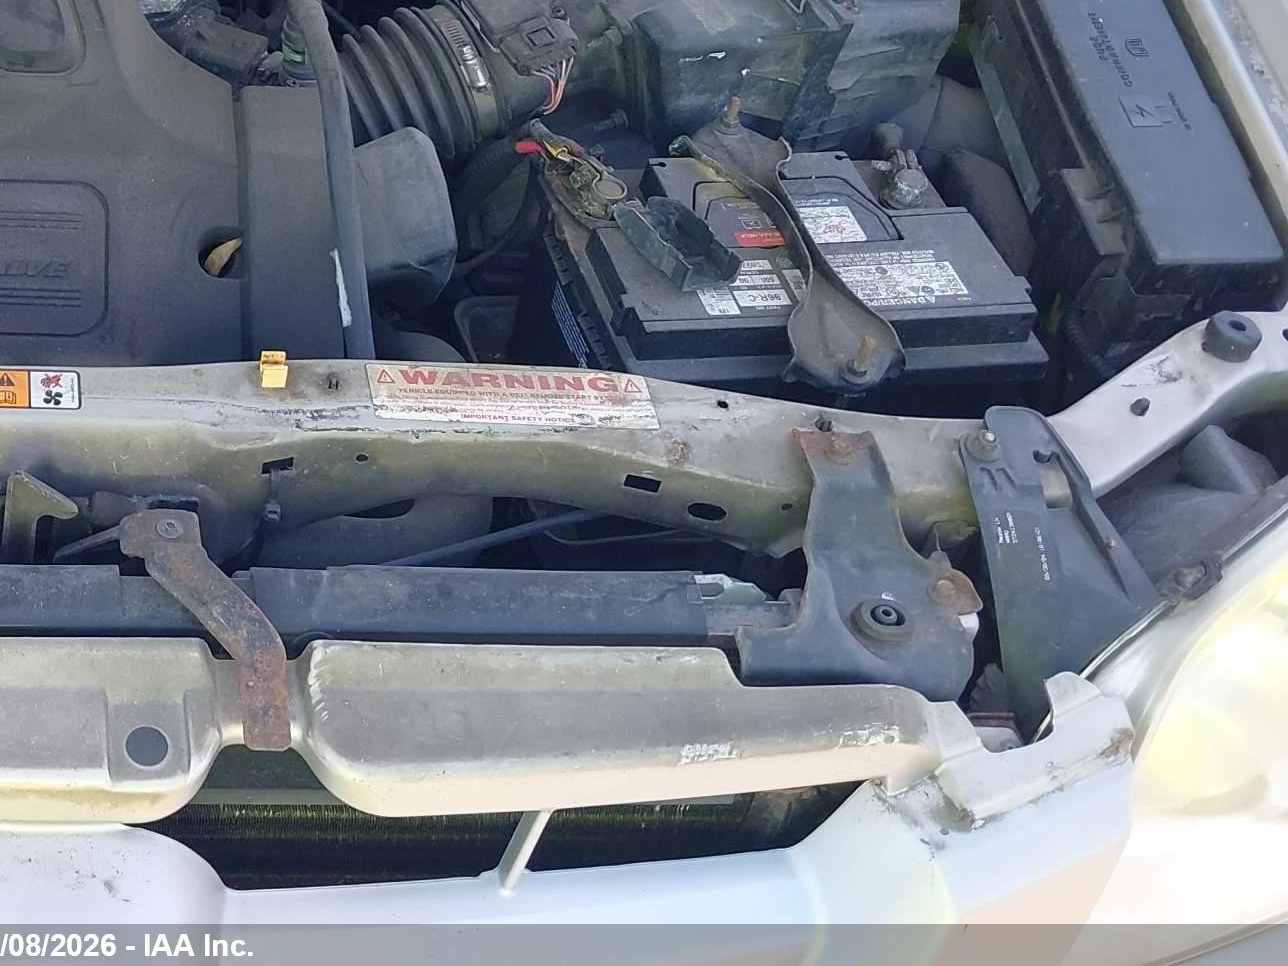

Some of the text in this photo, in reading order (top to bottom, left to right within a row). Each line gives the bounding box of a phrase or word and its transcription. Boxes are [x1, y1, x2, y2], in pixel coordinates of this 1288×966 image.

[398, 369, 619, 393] WARNING
[398, 387, 433, 395] VEHICLE
[434, 388, 476, 396] EQUIPPED
[461, 413, 509, 422] IMPORTANT
